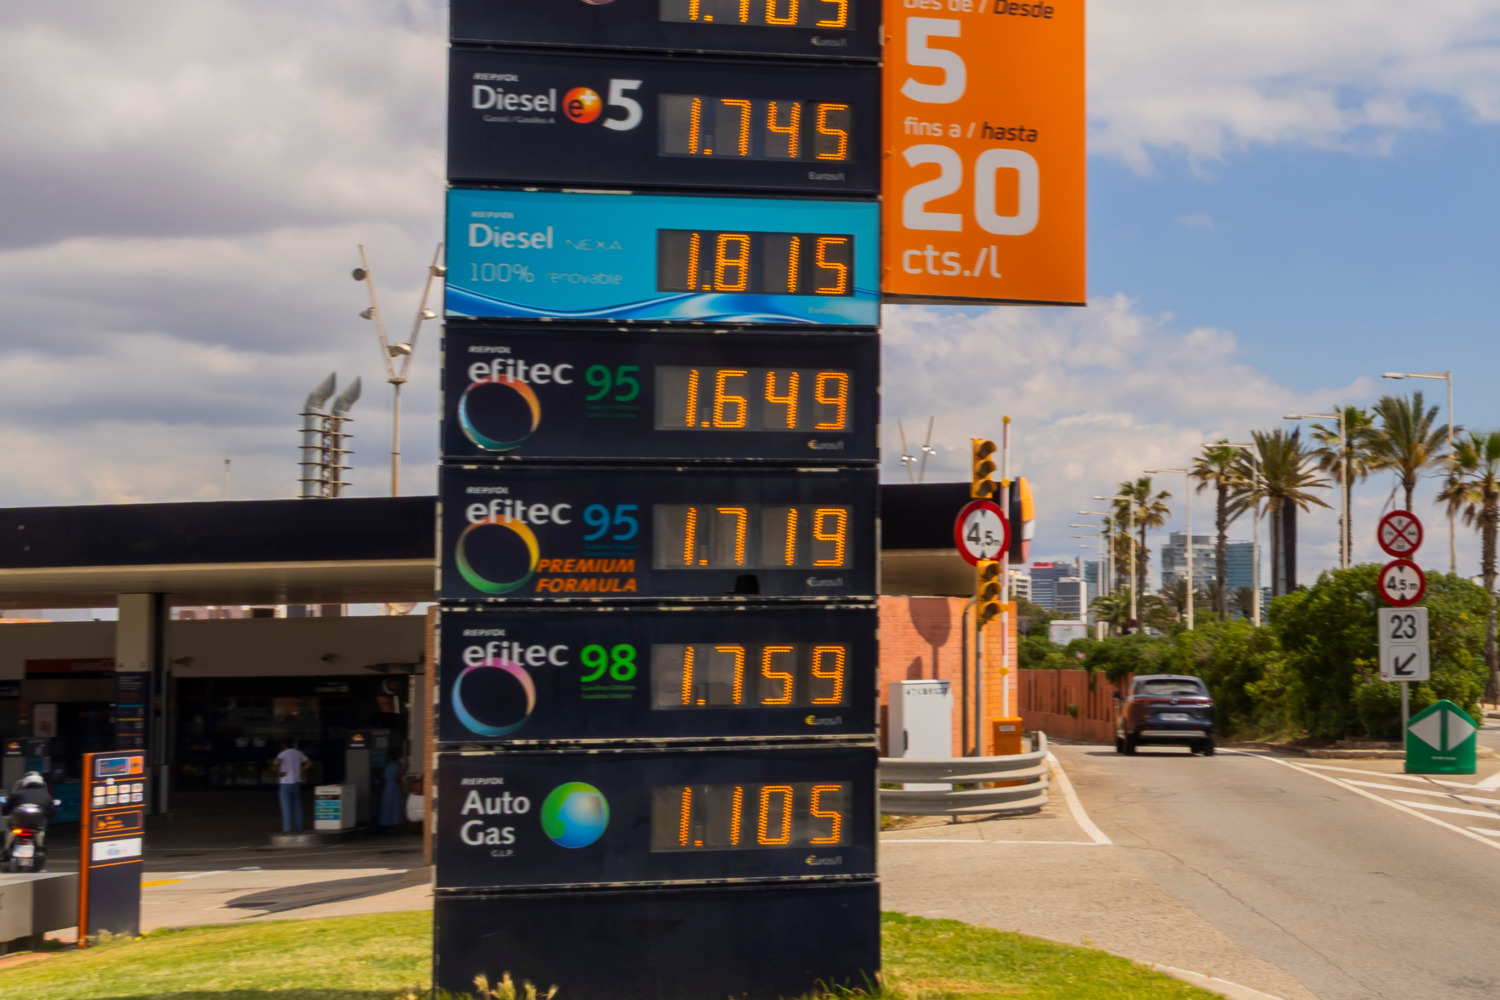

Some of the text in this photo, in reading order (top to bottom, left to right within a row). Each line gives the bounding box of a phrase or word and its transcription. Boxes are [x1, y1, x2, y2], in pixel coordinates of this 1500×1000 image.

[900, 16, 967, 104] 5
[472, 84, 557, 112] Diesel
[602, 79, 643, 131] 5
[688, 97, 849, 160] 1.745
[904, 116, 1038, 142] fins a / hasta
[902, 143, 1040, 236] 20
[469, 223, 623, 250] Diesel NEXA
[470, 262, 623, 285] 100% renovable
[686, 232, 848, 295] 1.815
[902, 244, 1002, 279] cts./l
[468, 358, 640, 402] efitec 95
[685, 369, 849, 430] 1.649
[466, 499, 639, 541] efitec 95
[684, 507, 848, 567] 1.719
[536, 558, 635, 573] PREMIUM
[536, 578, 637, 592] FORMULA
[1391, 615, 1417, 639] 23
[463, 641, 637, 682] efitec 98
[681, 645, 846, 705] 1.759
[461, 790, 531, 815] Auto
[679, 784, 842, 847] 1.105
[460, 819, 516, 846] Gas
